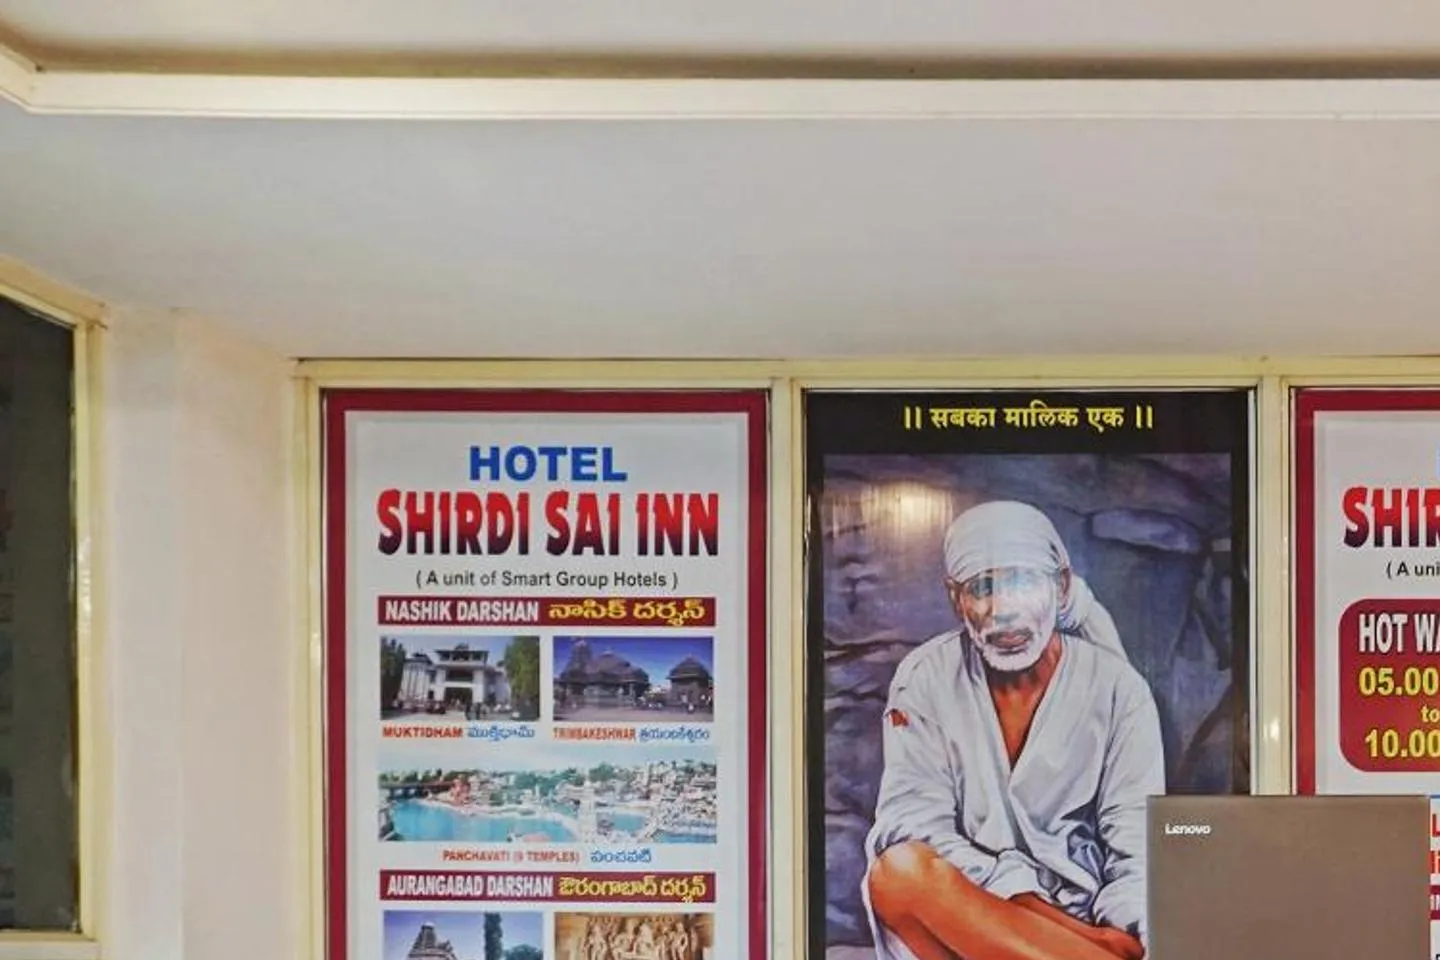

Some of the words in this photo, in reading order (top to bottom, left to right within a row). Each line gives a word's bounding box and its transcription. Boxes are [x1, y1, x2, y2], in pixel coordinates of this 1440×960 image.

[929, 407, 997, 428] सबका
[1003, 399, 1080, 428] मालिक
[1086, 406, 1125, 433] एक
[469, 446, 628, 482] HOTEL
[377, 489, 530, 555] SHIRDI
[545, 490, 620, 556] SAI
[636, 492, 719, 556] INN
[1396, 562, 1410, 576] A
[426, 572, 439, 586] A
[443, 571, 475, 587] unit
[480, 570, 497, 587] of
[501, 571, 551, 587] Smart
[556, 571, 608, 590] Group
[613, 571, 667, 588] Hotels
[385, 601, 451, 622] NASHIK
[456, 601, 539, 622] DARSHAN
[1358, 612, 1408, 654] HOT
[1359, 667, 1439, 696] 05.00
[1421, 704, 1440, 724] to
[382, 726, 463, 738] MUKTIDHAM
[1165, 823, 1212, 835] Lenovo
[442, 850, 510, 863] PANCHAVATI
[387, 875, 485, 897] AURANGABAD
[487, 876, 552, 898] DARSHAN
